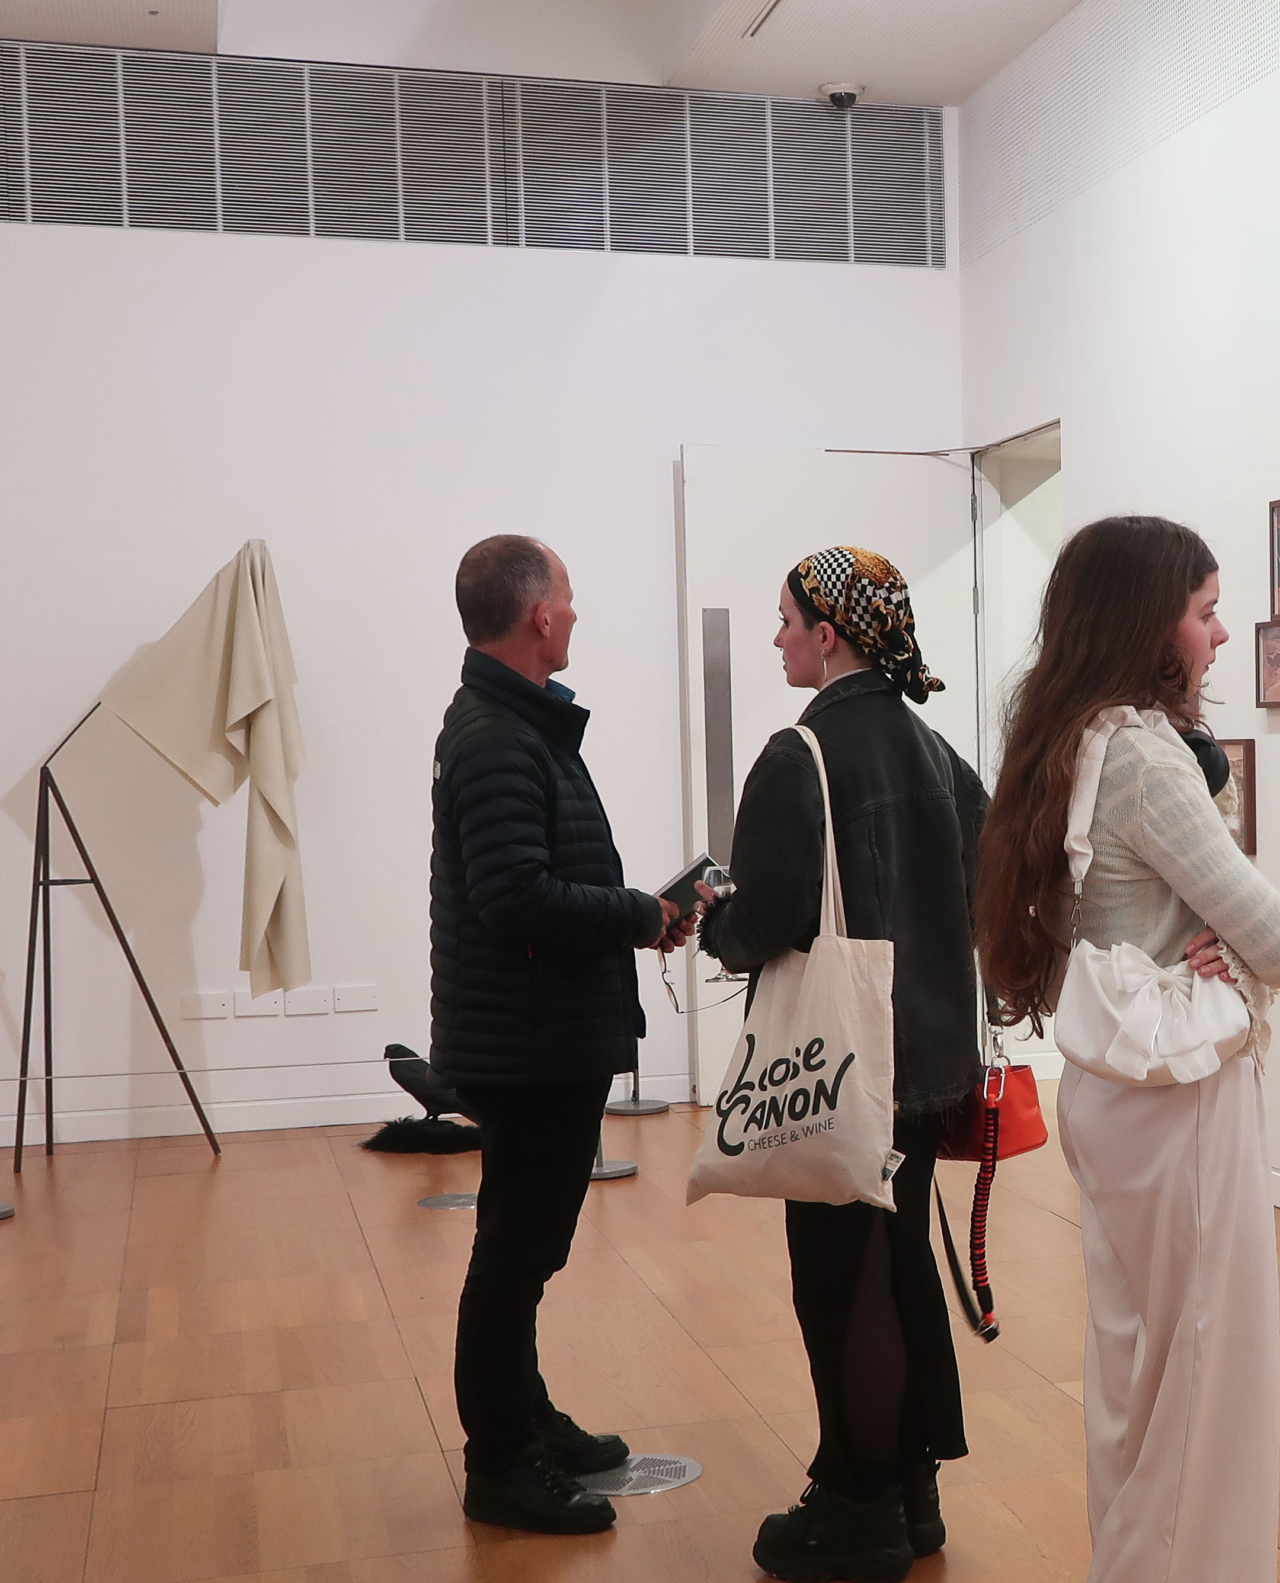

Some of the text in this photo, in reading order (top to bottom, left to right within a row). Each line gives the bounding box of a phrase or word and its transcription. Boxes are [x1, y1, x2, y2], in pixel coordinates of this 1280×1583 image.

[716, 1052, 855, 1156] CANON
[748, 1117, 835, 1151] CHEESE & WINE
